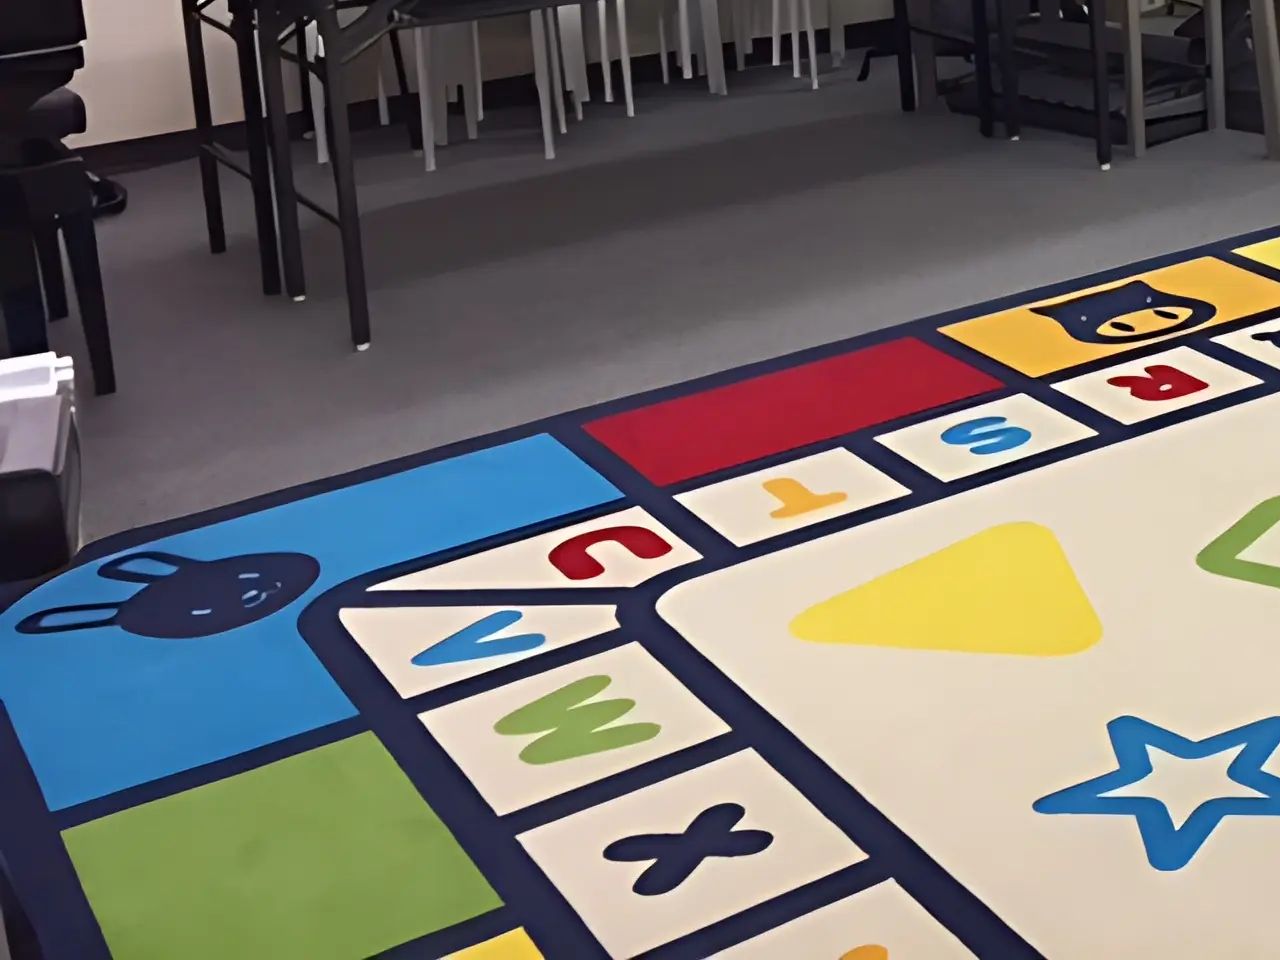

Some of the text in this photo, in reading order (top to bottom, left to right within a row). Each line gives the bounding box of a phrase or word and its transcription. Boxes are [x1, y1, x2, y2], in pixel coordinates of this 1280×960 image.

[1106, 363, 1210, 402] R
[940, 415, 1033, 455] S
[761, 476, 849, 521] T
[547, 525, 673, 581] U
[411, 609, 775, 897] V W X
